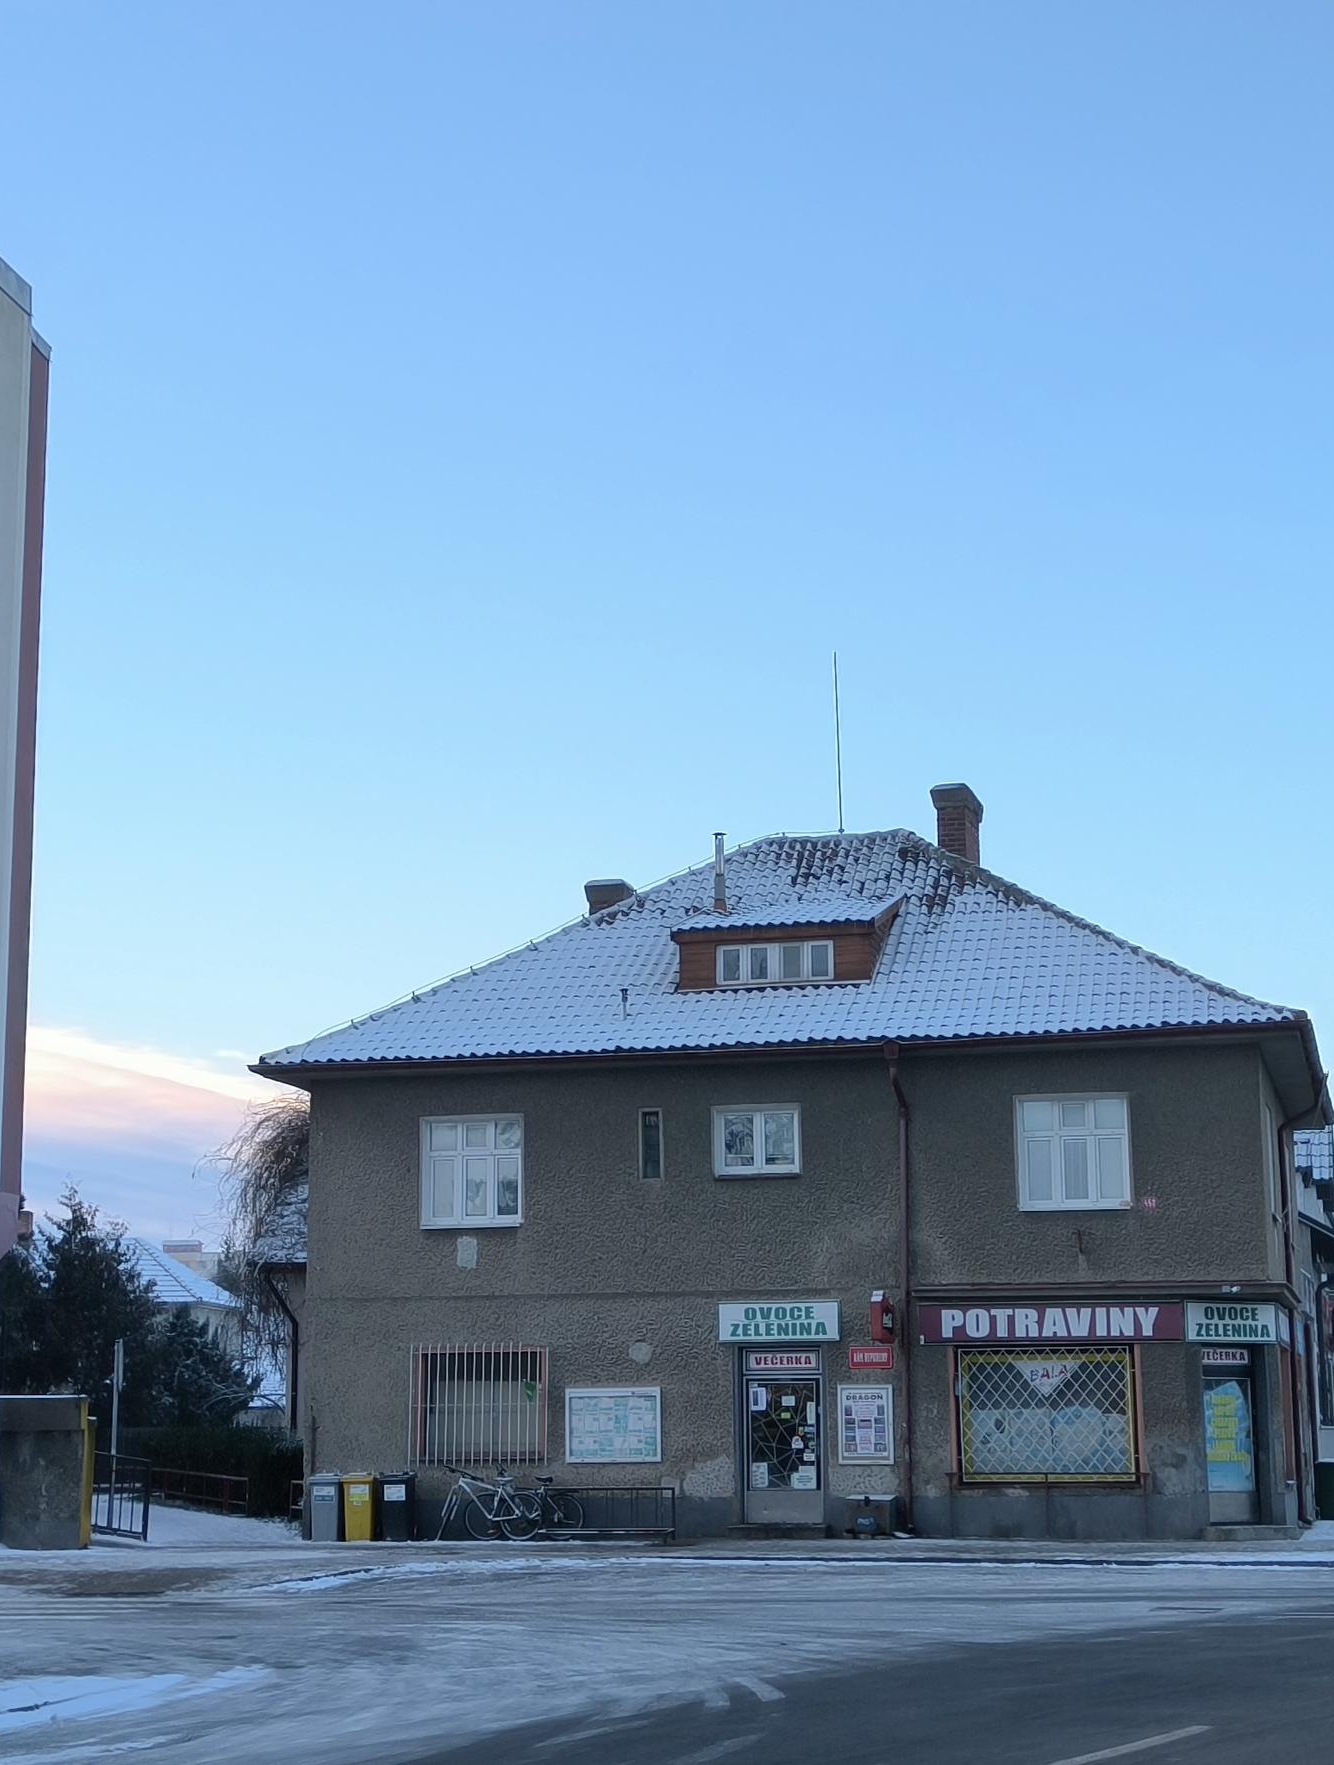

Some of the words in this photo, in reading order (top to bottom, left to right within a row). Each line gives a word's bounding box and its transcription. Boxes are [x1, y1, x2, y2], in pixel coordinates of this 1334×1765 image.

[744, 1306, 815, 1321] OVOCE
[1204, 1306, 1259, 1321] OVOCE
[730, 1322, 828, 1337] ZELENINA
[941, 1307, 1159, 1338] POTRAVINY
[1195, 1323, 1271, 1338] ZELENINA
[754, 1353, 812, 1366] VEČERKA
